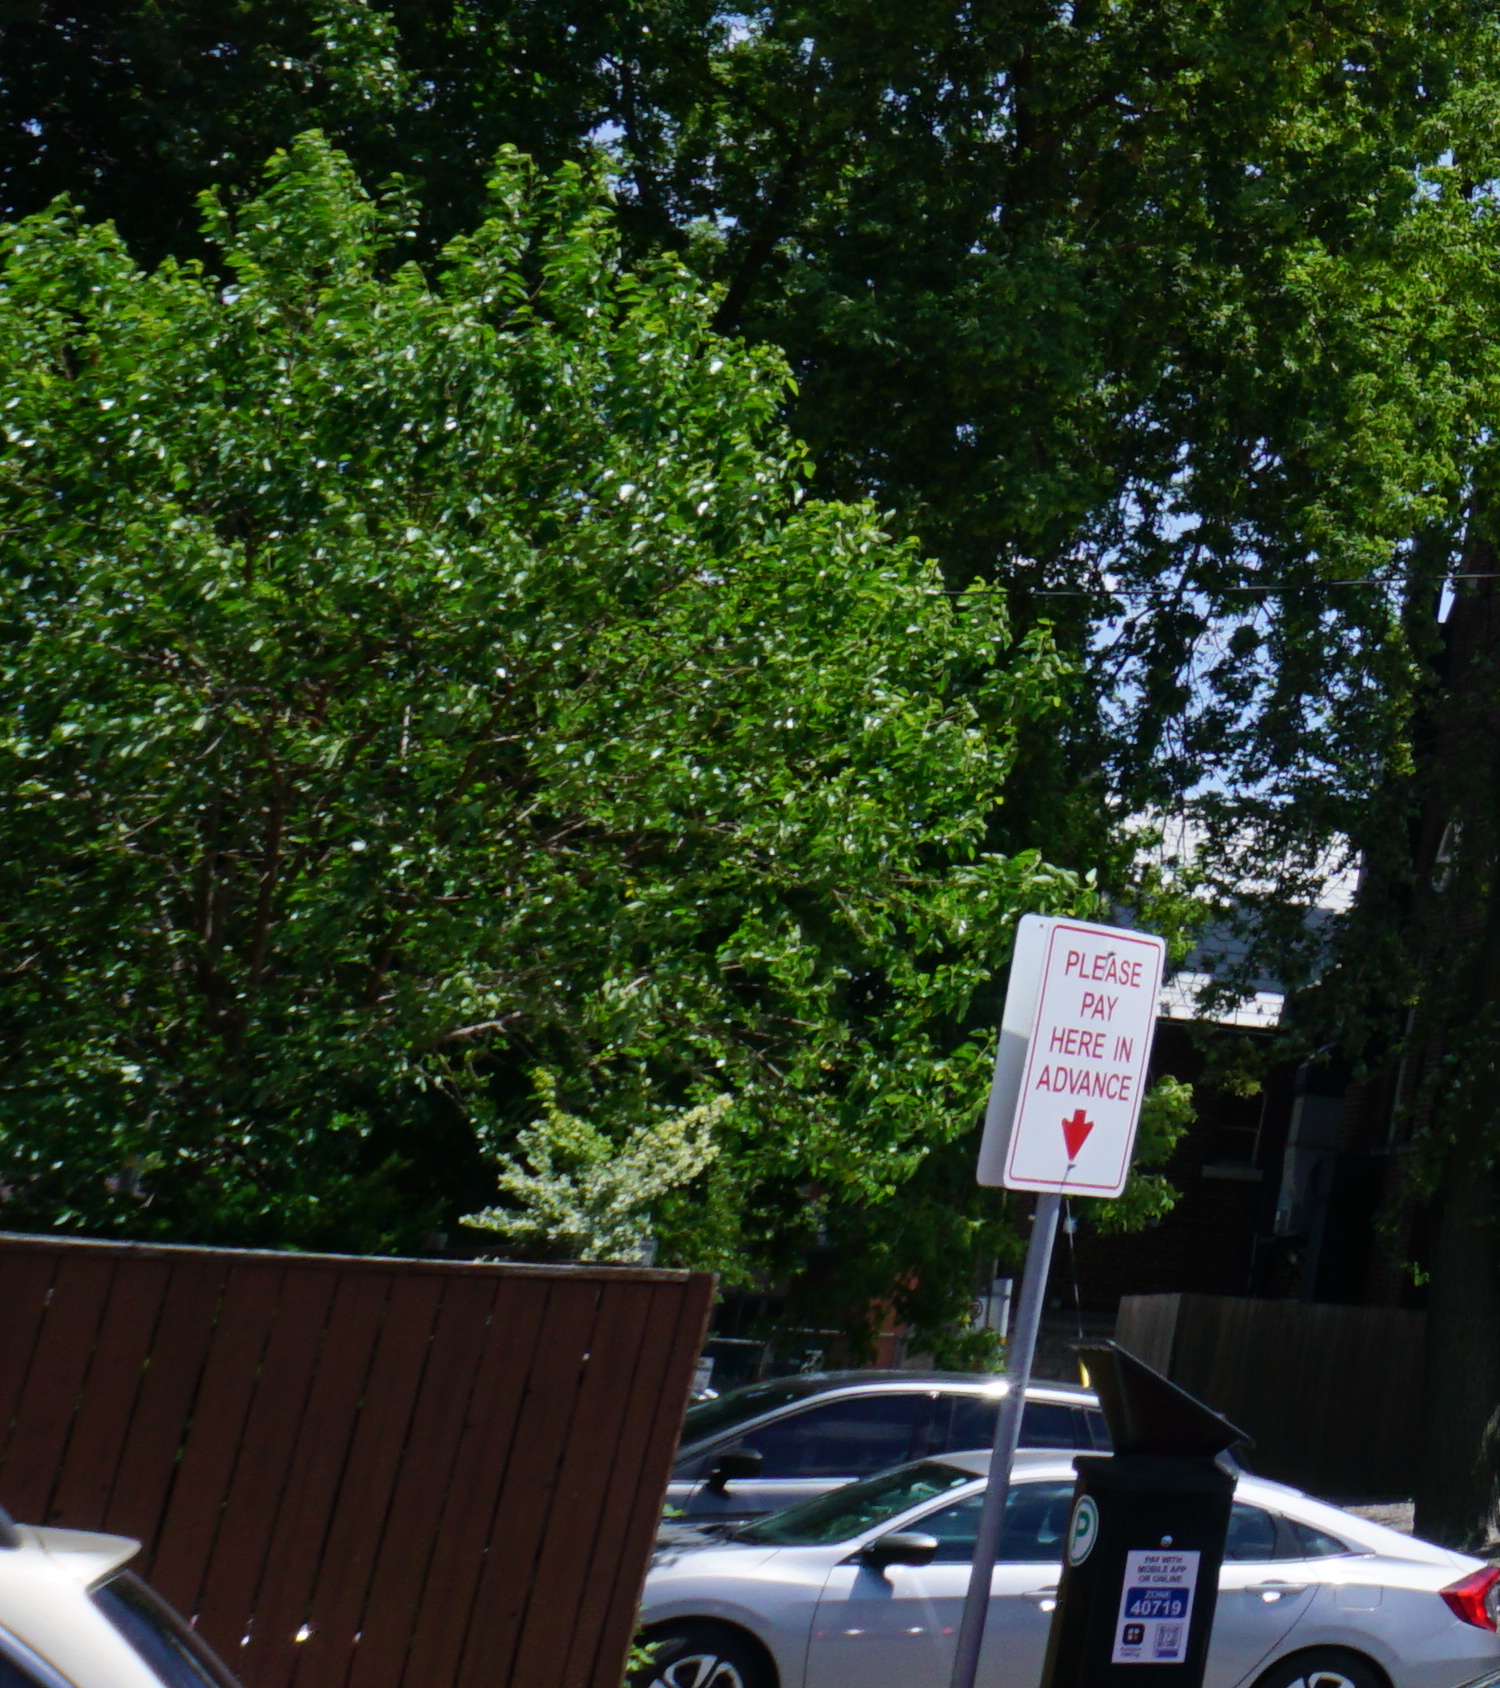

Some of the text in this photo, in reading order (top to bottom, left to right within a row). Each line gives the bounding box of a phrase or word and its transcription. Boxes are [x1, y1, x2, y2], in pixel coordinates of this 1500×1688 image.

[1064, 950, 1143, 988] PLEASE
[1080, 991, 1119, 1021] PAY
[1049, 1026, 1134, 1063] HERE IN
[1035, 1064, 1133, 1102] ADVANCE
[1073, 1511, 1090, 1549] P
[1138, 1565, 1187, 1573] MOBILE APP
[1145, 1556, 1183, 1564] PAY WITH
[1130, 1600, 1182, 1616] 40719
[1144, 1590, 1172, 1599] ZONE
